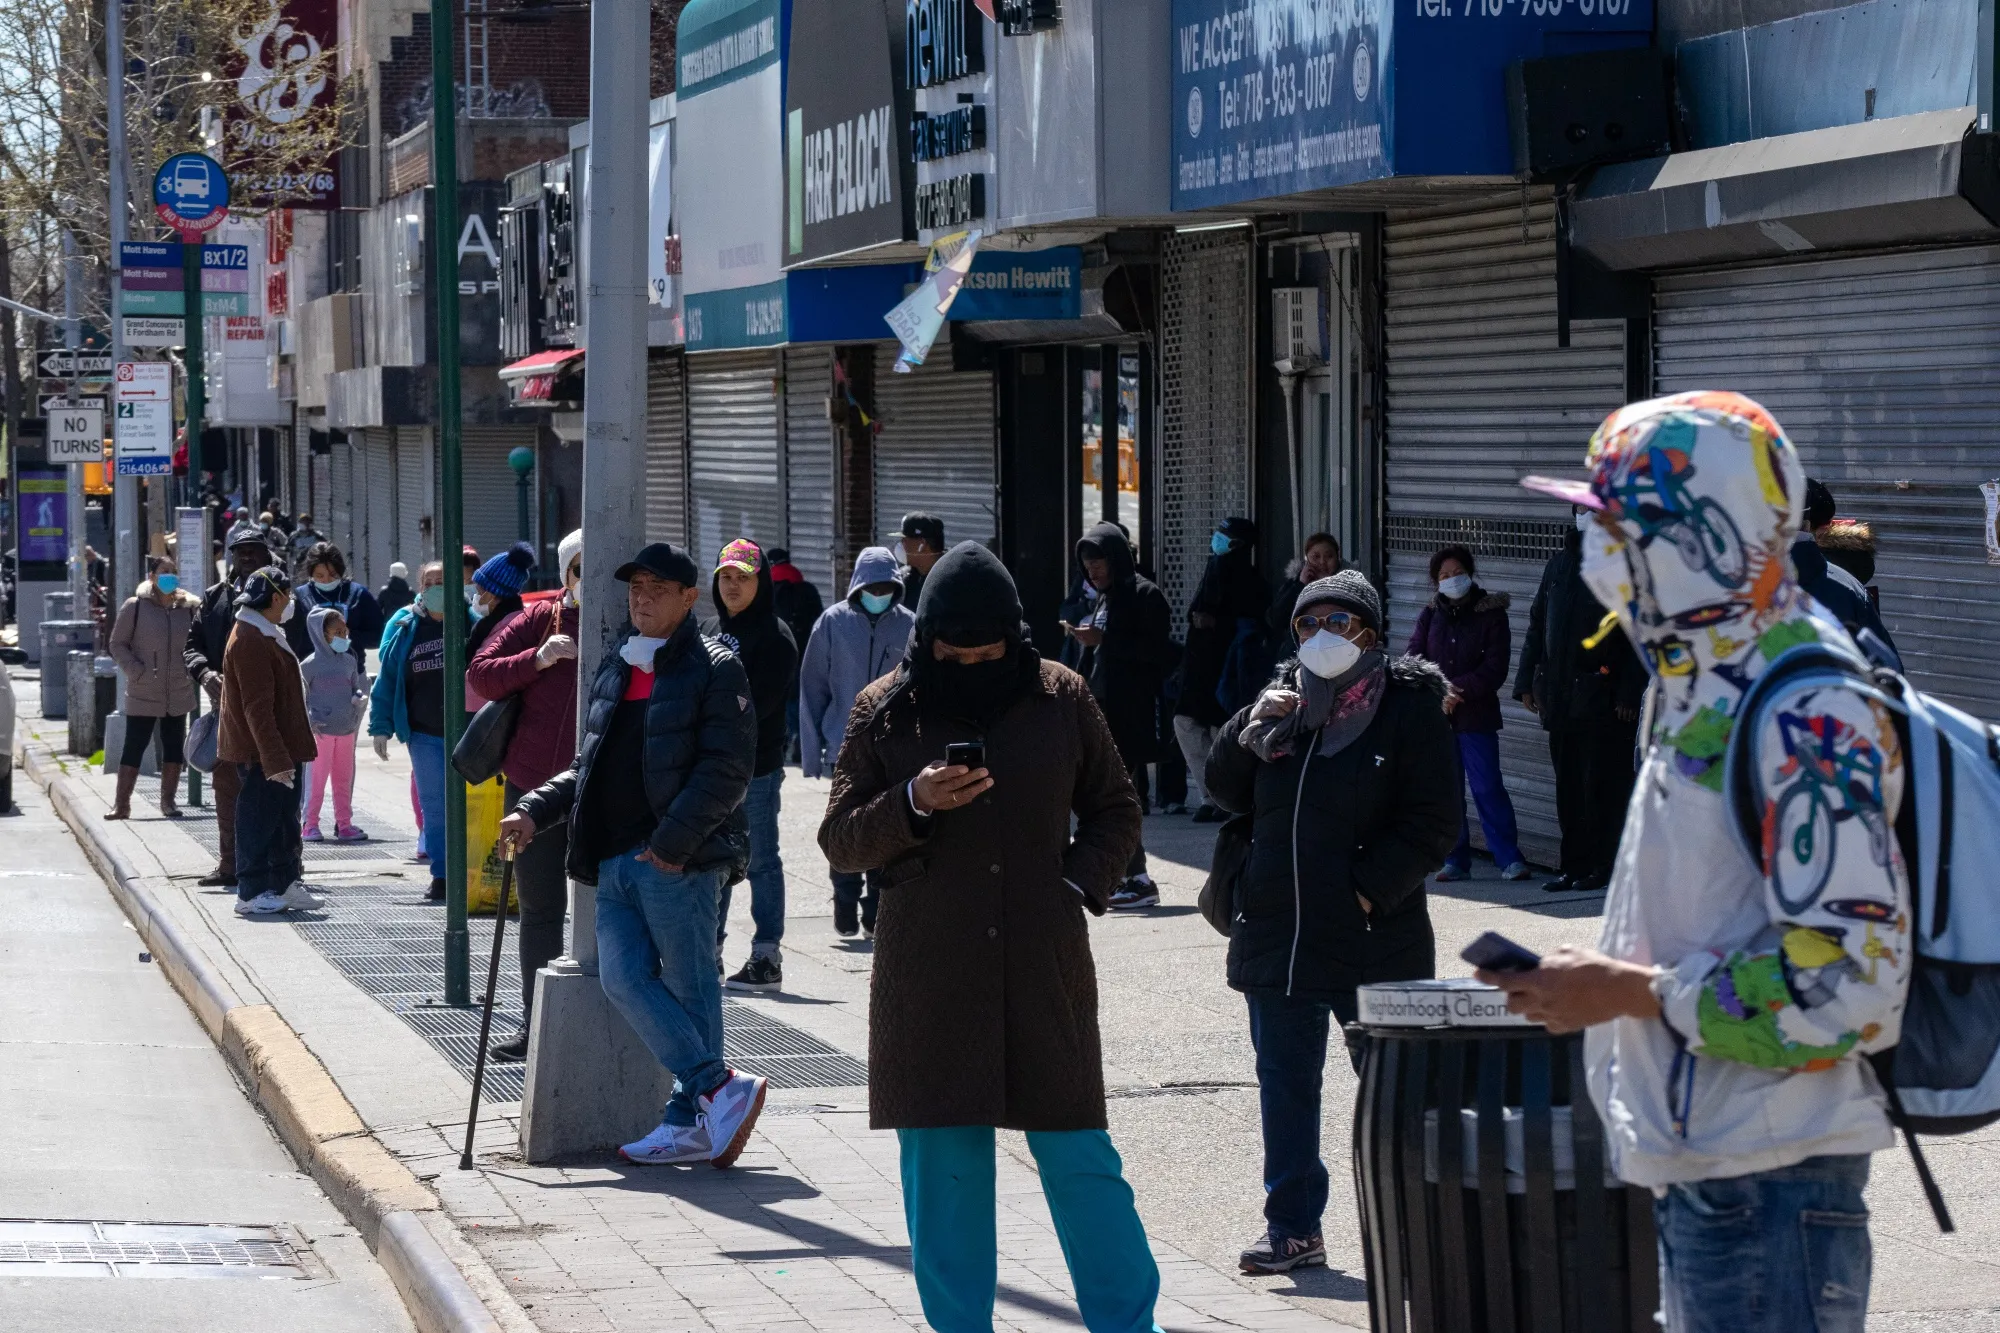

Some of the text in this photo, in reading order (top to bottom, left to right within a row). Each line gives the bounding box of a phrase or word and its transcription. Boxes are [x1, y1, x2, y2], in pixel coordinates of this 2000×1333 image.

[1180, 25, 1200, 74] WE
[1202, 9, 1251, 69] ACCEPT
[1219, 78, 1239, 129] Tel:
[1244, 52, 1335, 124] 718-933-0187
[805, 104, 892, 225] H&R BLOCK
[162, 208, 223, 229] NO STANDING
[123, 245, 167, 255] Mott Haven
[123, 269, 167, 278] Mott Haven
[962, 266, 1071, 290] kson Hewitt
[126, 320, 144, 328] Grand
[145, 321, 177, 329] Concourse
[126, 328, 131, 336] E
[133, 328, 165, 336] Fordham
[227, 329, 265, 341] REPAIR
[48, 359, 107, 370] ONE WAY
[120, 402, 131, 417] 2
[64, 417, 87, 433] NO
[52, 440, 100, 453] TURNS
[120, 463, 158, 474] 216406
[409, 638, 444, 660] LAFAY
[1454, 992, 1508, 1018] Clean
